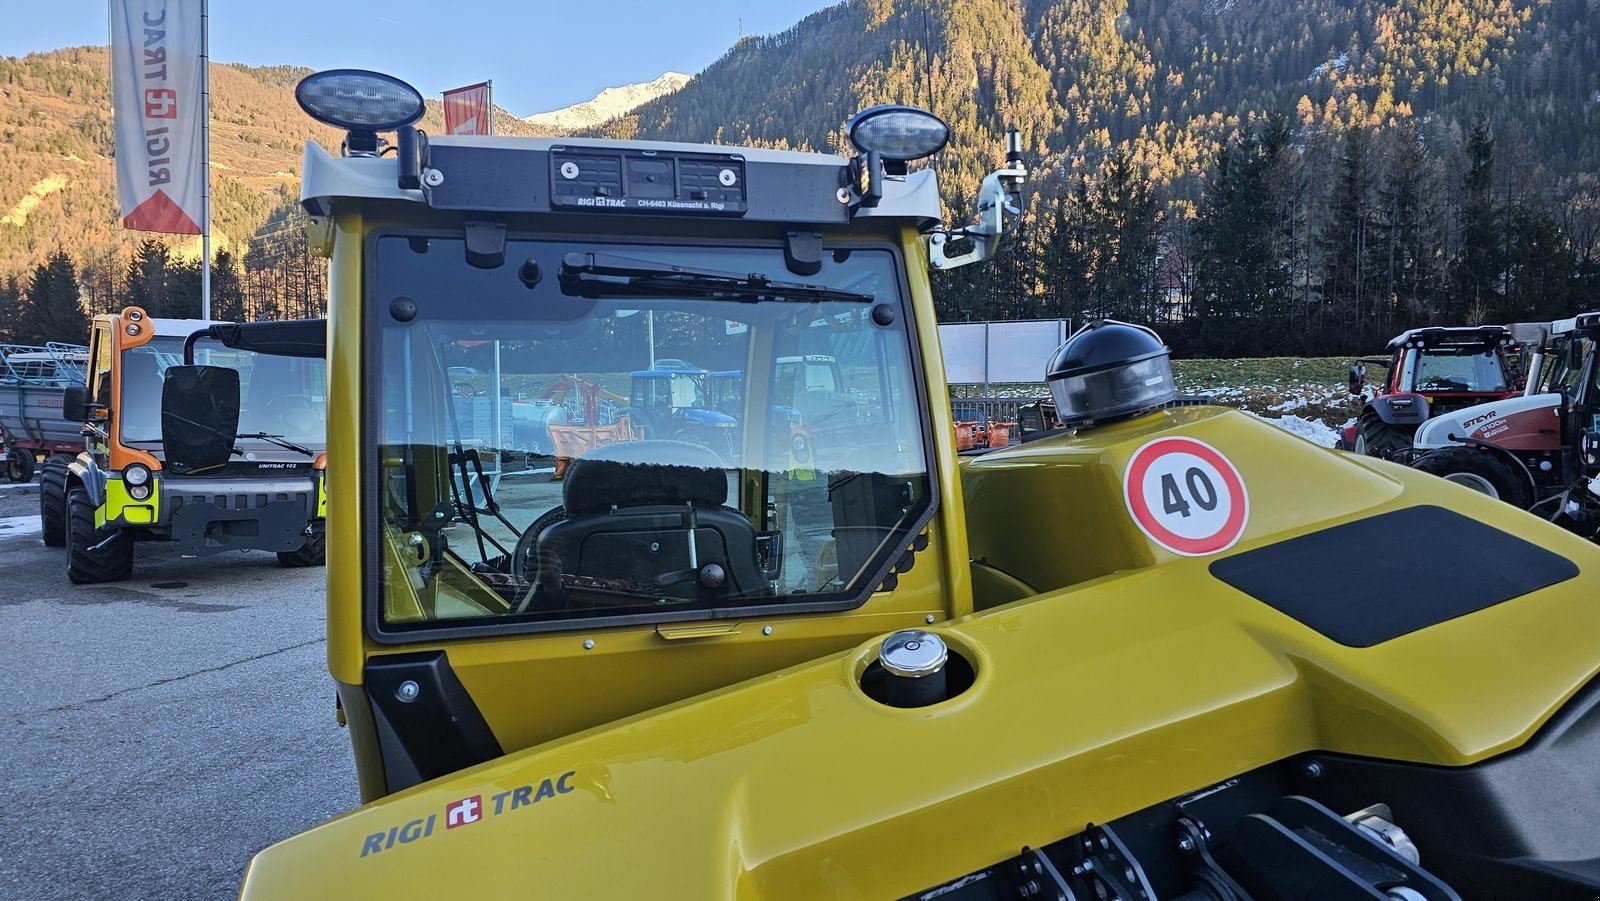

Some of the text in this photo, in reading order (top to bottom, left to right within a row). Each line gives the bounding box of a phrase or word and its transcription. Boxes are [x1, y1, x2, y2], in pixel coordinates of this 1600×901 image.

[577, 197, 595, 206] RIGI
[606, 199, 626, 207] TRAC
[711, 202, 725, 211] Rigi
[1462, 410, 1497, 429] STEYR
[1160, 466, 1218, 518] 40
[359, 814, 437, 858] RIGI
[491, 770, 576, 816] TRAC
